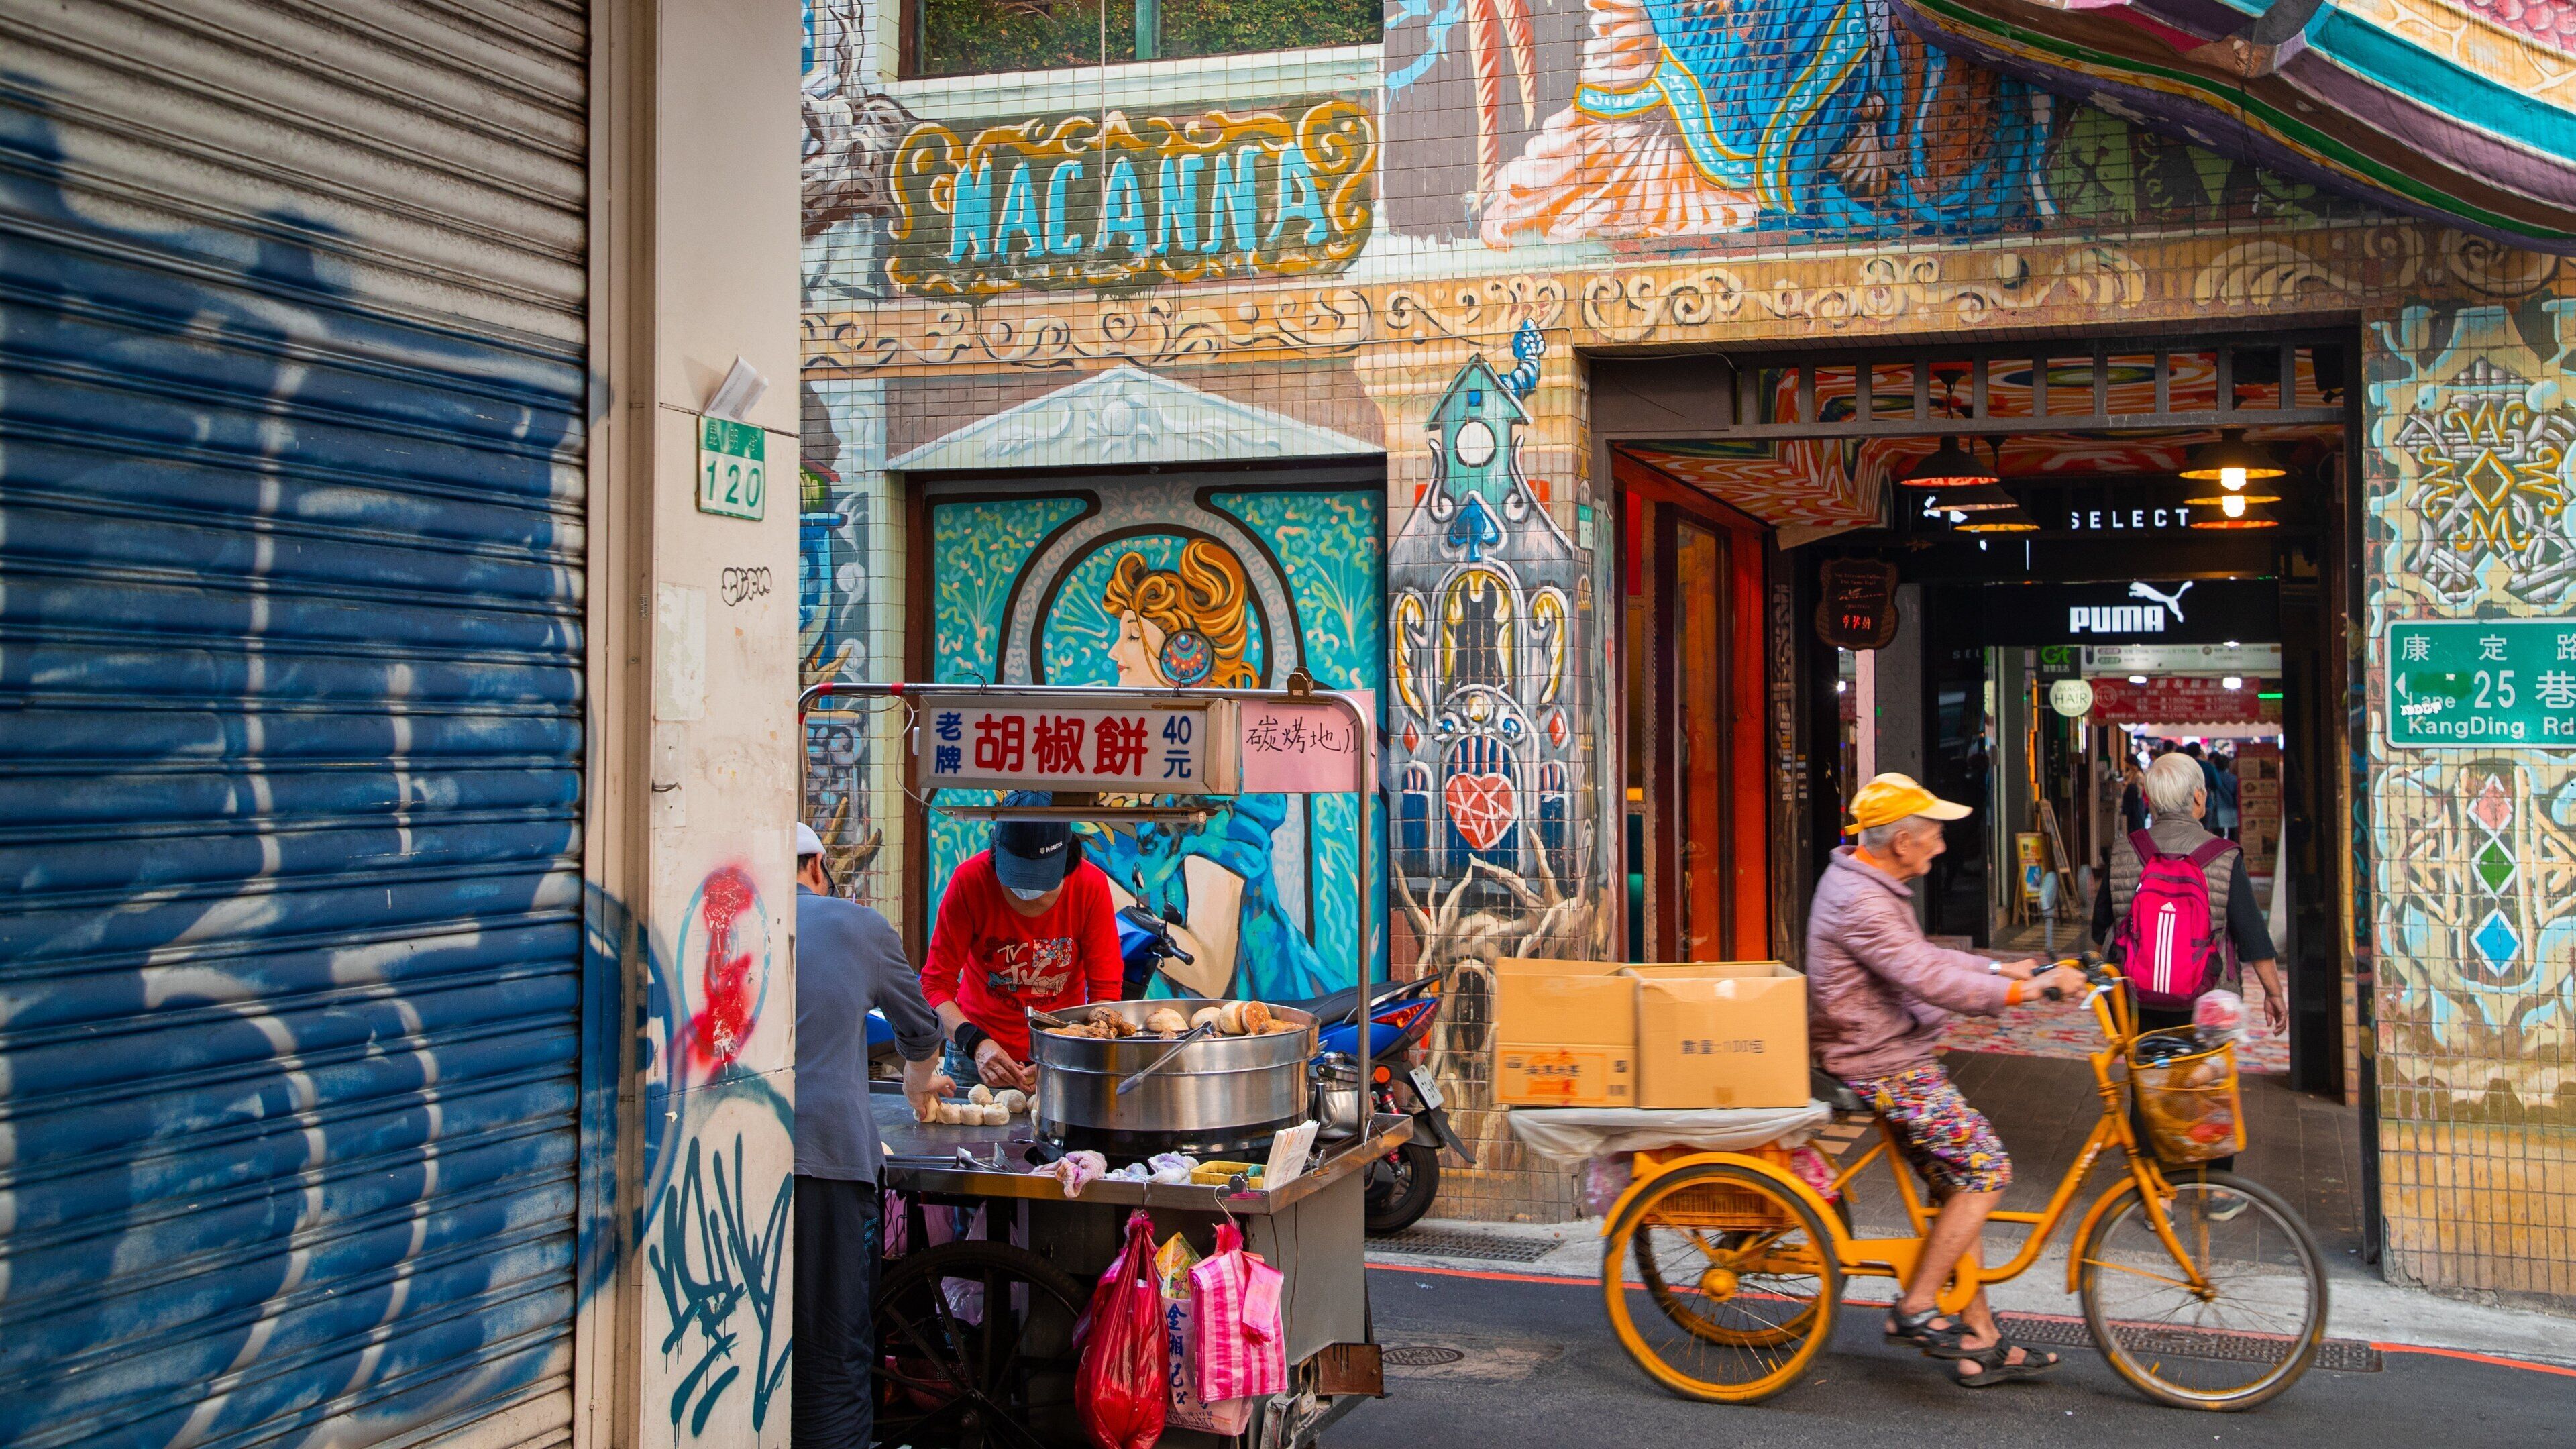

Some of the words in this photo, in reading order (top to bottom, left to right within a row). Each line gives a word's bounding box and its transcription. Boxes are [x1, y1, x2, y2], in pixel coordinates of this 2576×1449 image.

[706, 460, 761, 508] 120
[2072, 508, 2190, 530] SELECT
[2070, 605, 2165, 633] PUMA
[2401, 633, 2576, 661] 康定路
[2055, 693, 2088, 704] HAIR
[2473, 669, 2516, 709] 25
[2535, 669, 2576, 709] 巷
[2408, 716, 2525, 739] KangDing
[935, 710, 962, 774] 老牌
[975, 713, 1148, 777] 胡椒餅
